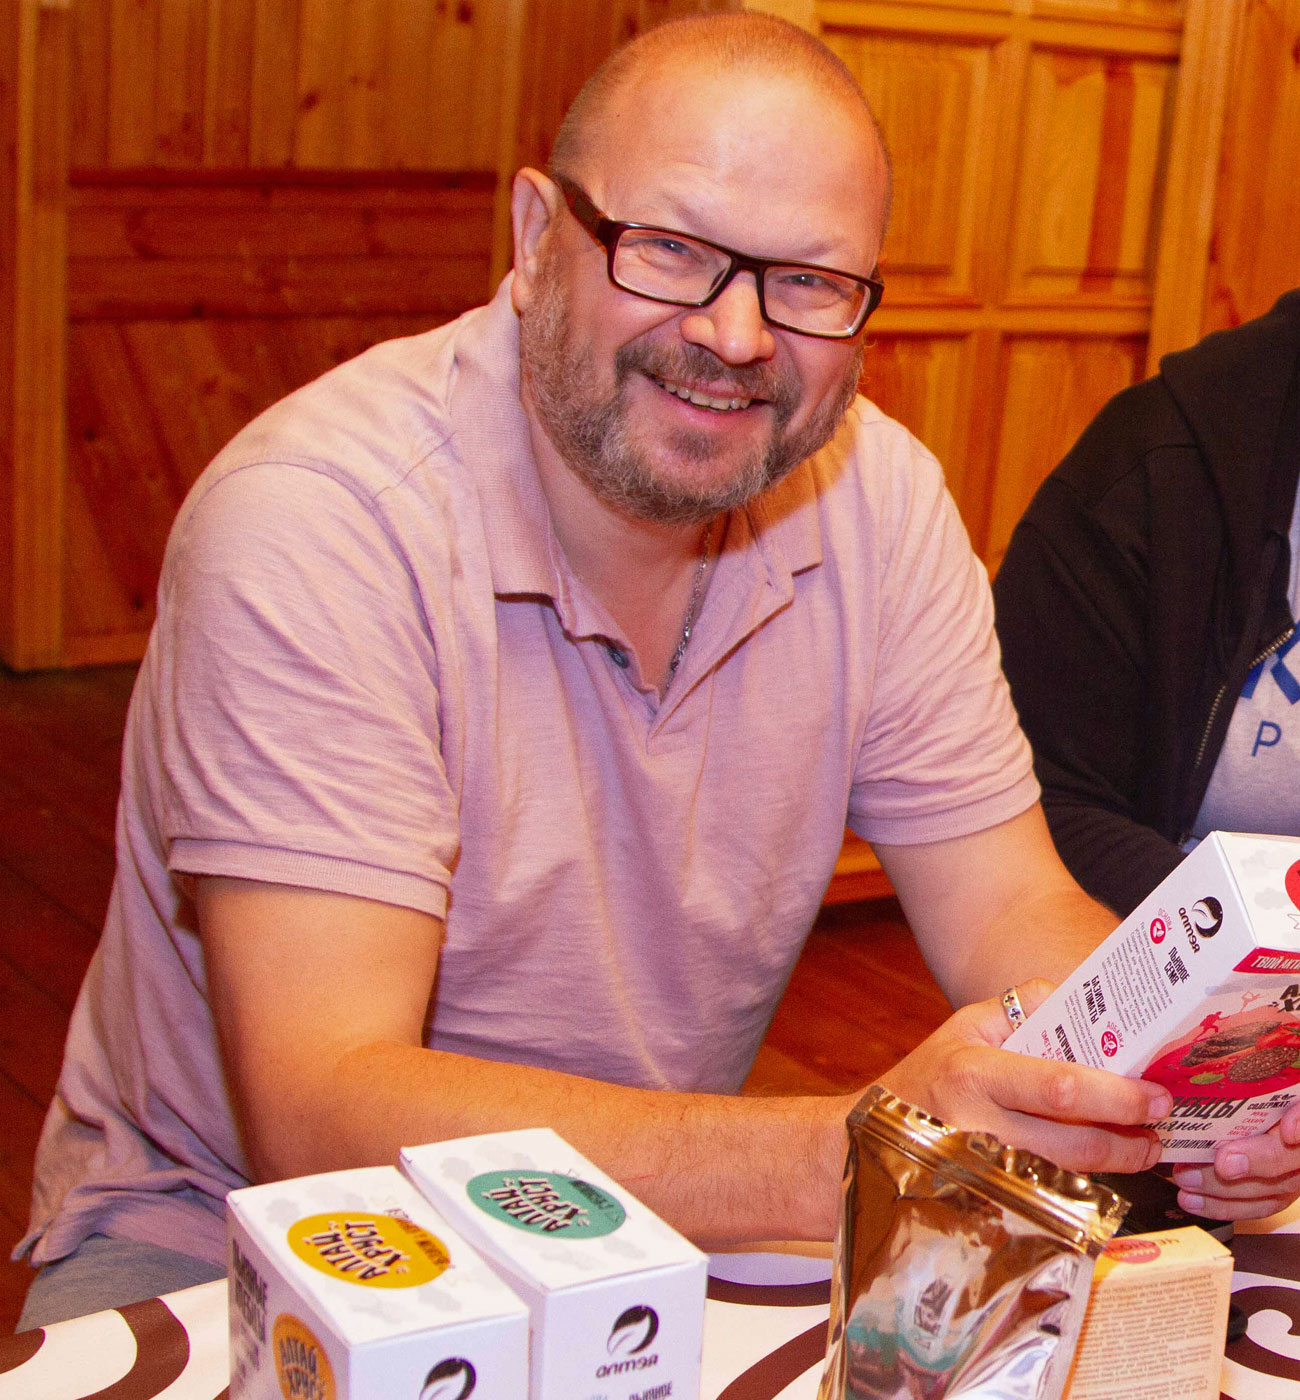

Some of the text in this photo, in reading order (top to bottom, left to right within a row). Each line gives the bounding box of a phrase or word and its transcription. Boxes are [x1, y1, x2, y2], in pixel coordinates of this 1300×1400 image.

[1164, 961, 1180, 986] СЕМЯ
[1168, 946, 1191, 984] ЛЬНЯНОЕ
[1251, 955, 1282, 970] ТВОЙ
[1085, 989, 1100, 1025] ТОМАТЫ
[1091, 974, 1108, 1015] БАЗИЛИК
[481, 1188, 571, 1231] АЛТАЙ
[518, 1177, 580, 1220] ХРУСТ
[303, 1230, 388, 1279] АЛТАЙ
[345, 1221, 402, 1266] ХРУСТ
